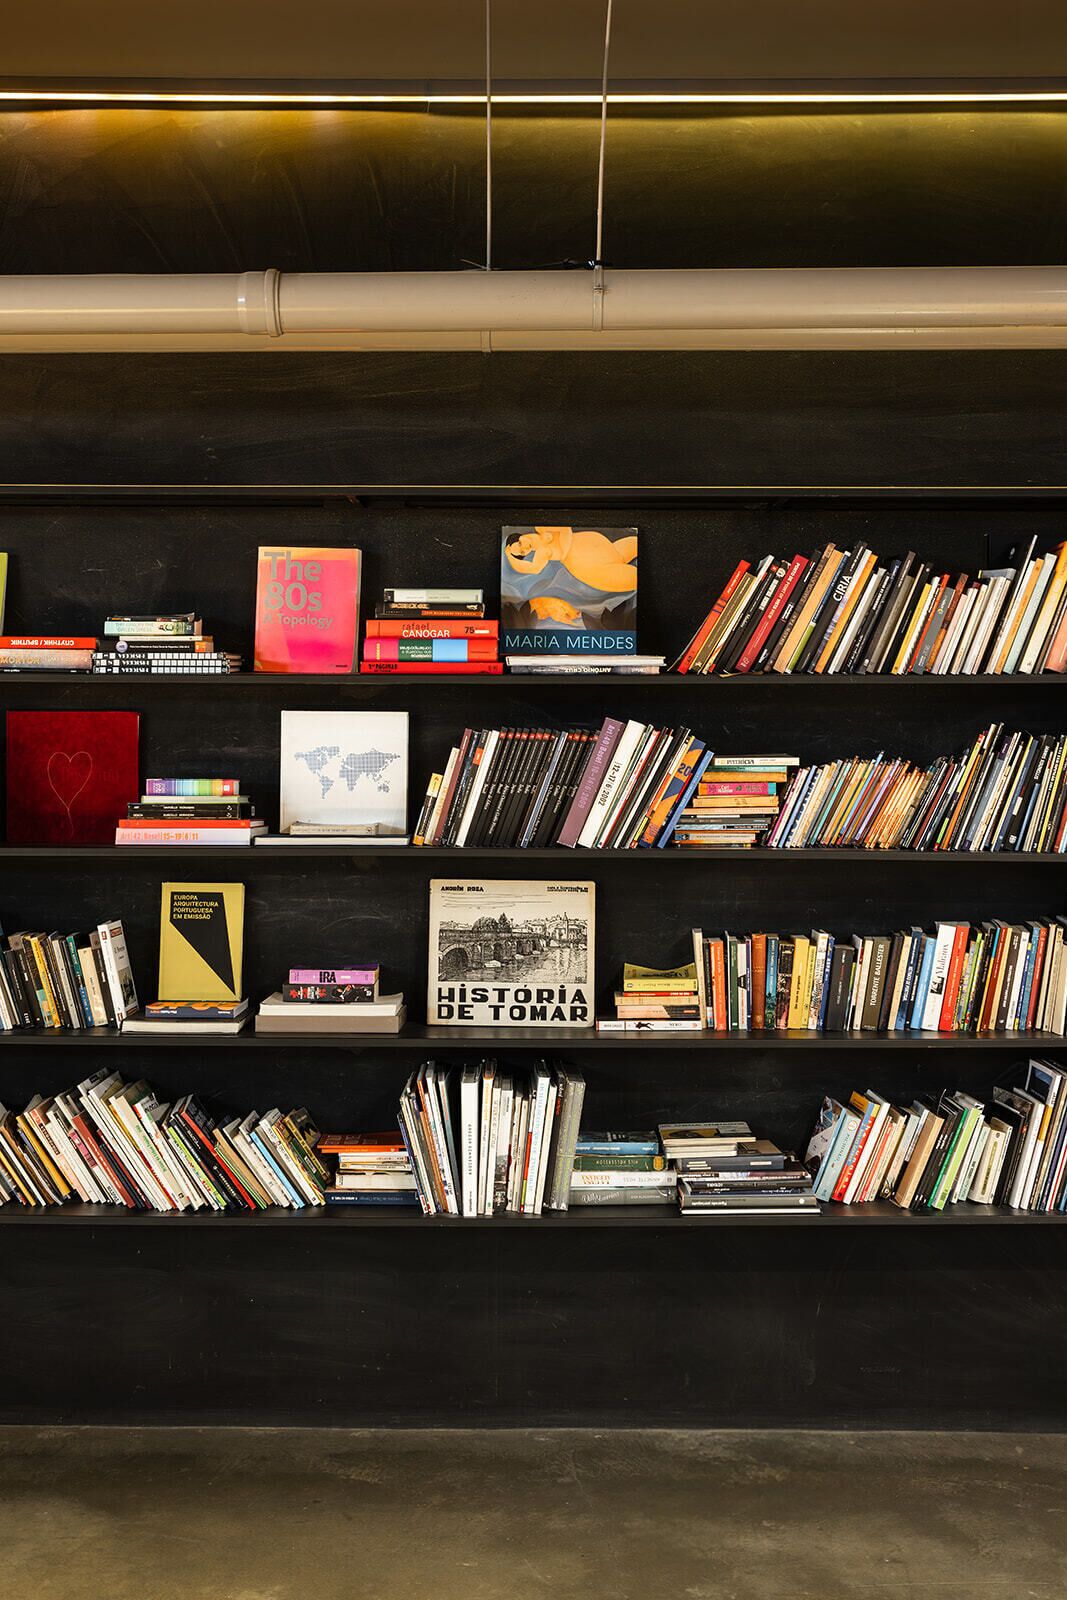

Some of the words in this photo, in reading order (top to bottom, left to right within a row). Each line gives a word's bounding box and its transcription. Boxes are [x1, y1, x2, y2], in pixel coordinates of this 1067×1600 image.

[263, 550, 322, 581] The
[833, 574, 852, 602] CIRIA
[264, 582, 323, 612] 80s
[276, 613, 334, 630] Topology
[402, 622, 430, 631] rafael
[402, 630, 451, 638] CANOGAR
[464, 626, 475, 634] 75
[505, 635, 560, 648] MARIA
[566, 636, 633, 649] MENDES
[677, 763, 692, 777] 20
[183, 912, 211, 920] EMISSÃO
[319, 971, 337, 983] IRA
[869, 977, 879, 1006] TORRENTE
[874, 944, 885, 976] BALLESTER
[437, 983, 588, 1004] HISTÓRIA
[437, 1004, 474, 1020] DE
[487, 1005, 589, 1022] TOMAR
